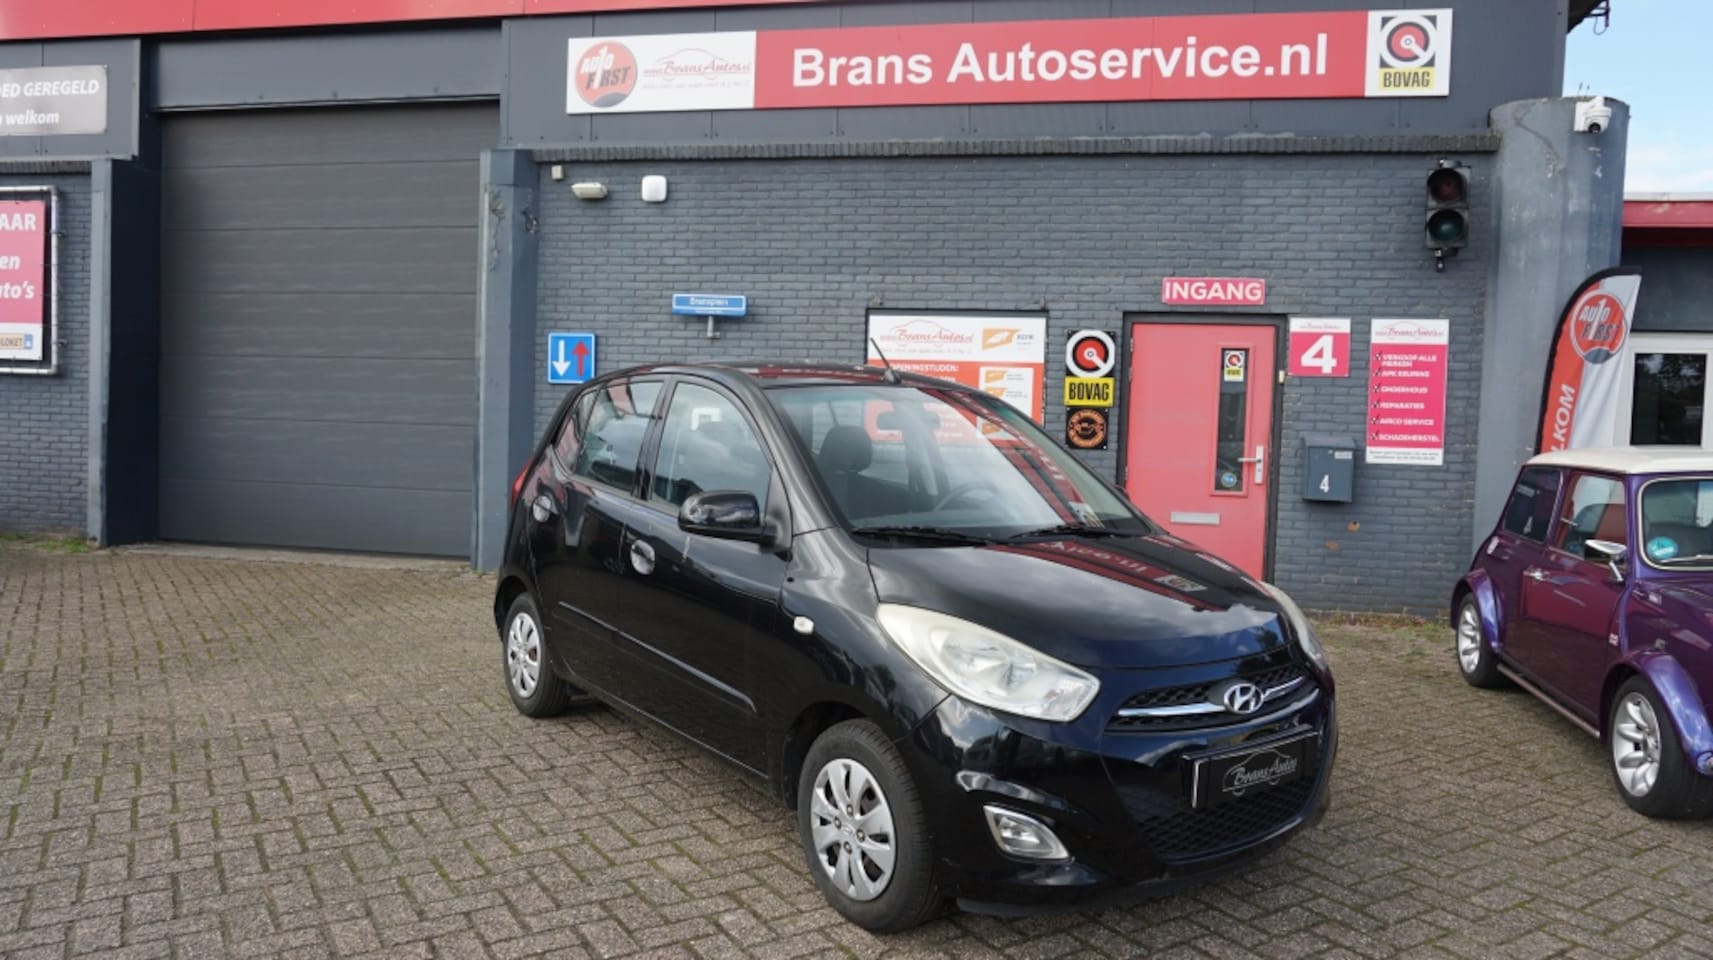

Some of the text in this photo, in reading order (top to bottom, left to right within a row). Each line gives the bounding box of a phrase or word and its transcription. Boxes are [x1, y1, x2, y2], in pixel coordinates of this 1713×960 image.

[793, 33, 1327, 87] Brans Autoservice.nl
[585, 67, 631, 90] FIRST
[1383, 70, 1430, 88] BOVAG
[0, 79, 99, 98] ED GEREGELD
[6, 109, 60, 125] welkom
[0, 281, 35, 299] to's
[1165, 282, 1262, 300] INGANG
[1579, 299, 1611, 322] AUTO
[1301, 335, 1337, 374] 4
[1069, 382, 1109, 401] BOVAG
[1320, 474, 1330, 493] 4
